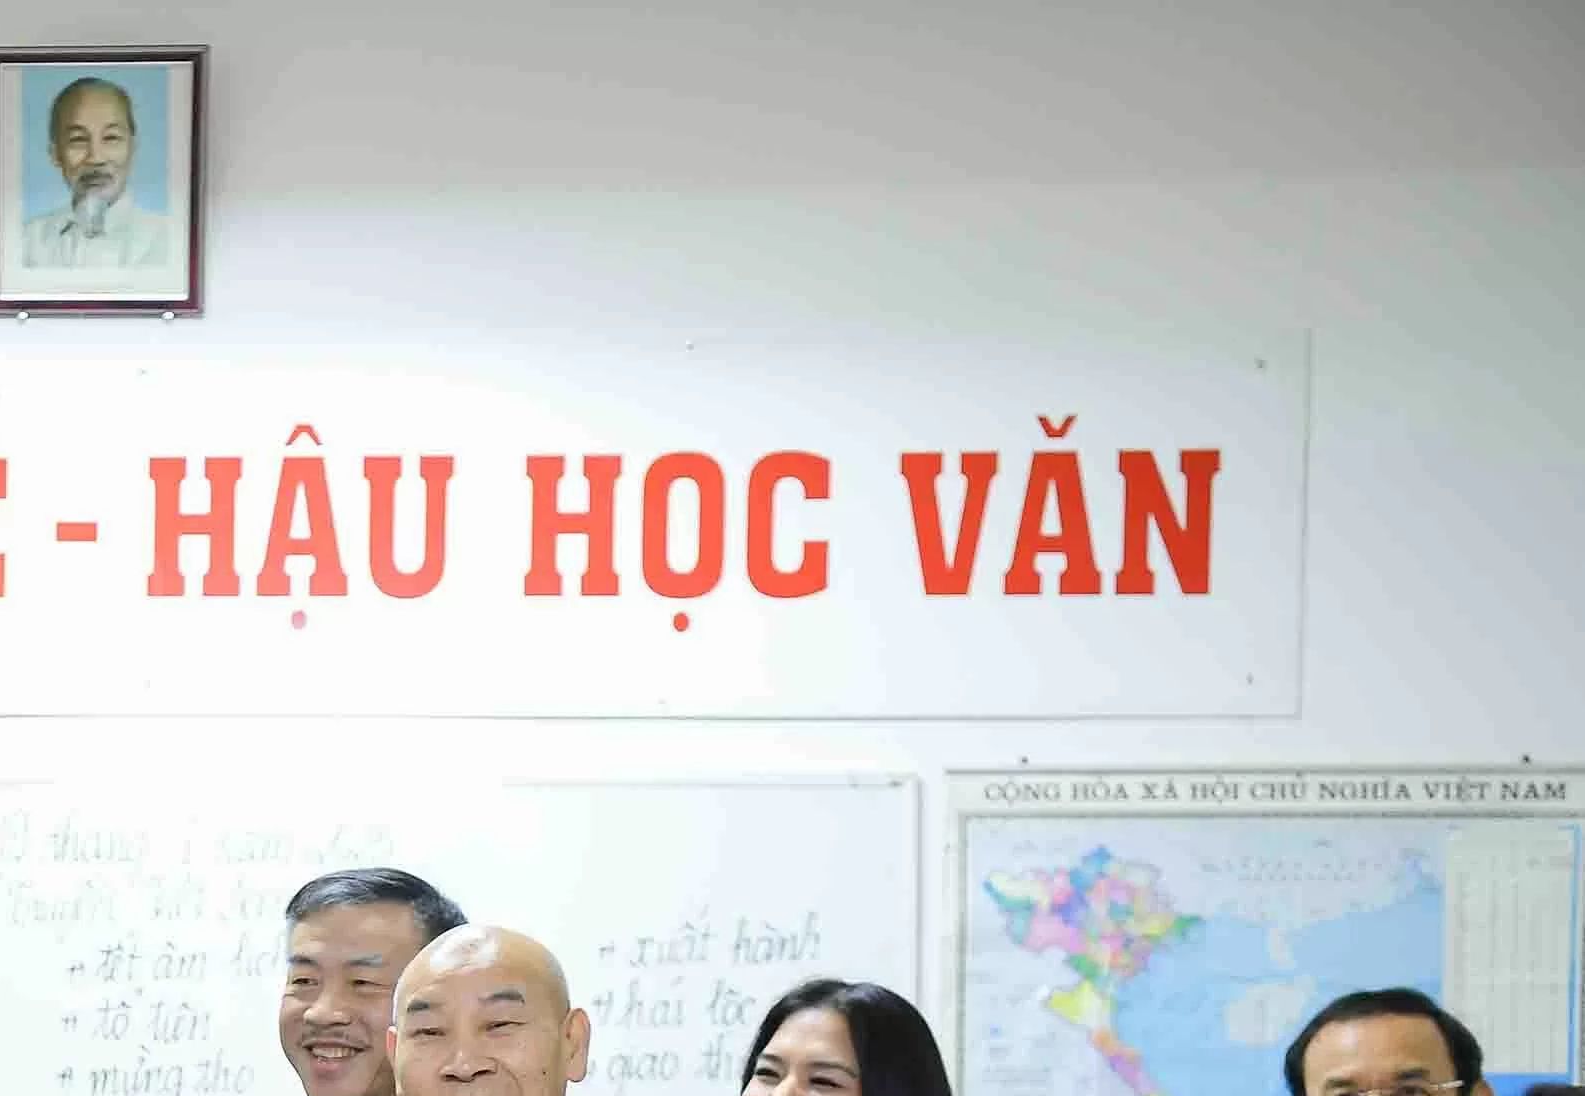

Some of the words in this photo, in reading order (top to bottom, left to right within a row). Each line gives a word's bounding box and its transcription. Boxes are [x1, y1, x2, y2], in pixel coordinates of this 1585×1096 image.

[146, 423, 456, 630] HẬU
[524, 450, 833, 633] HỌC
[898, 415, 1222, 597] VĂN
[983, 775, 1061, 807] CỘNG
[1189, 774, 1240, 804] HỘI
[1249, 770, 1308, 801] CHỦ
[1422, 776, 1493, 805] VIỆT
[1501, 781, 1567, 801] NAM
